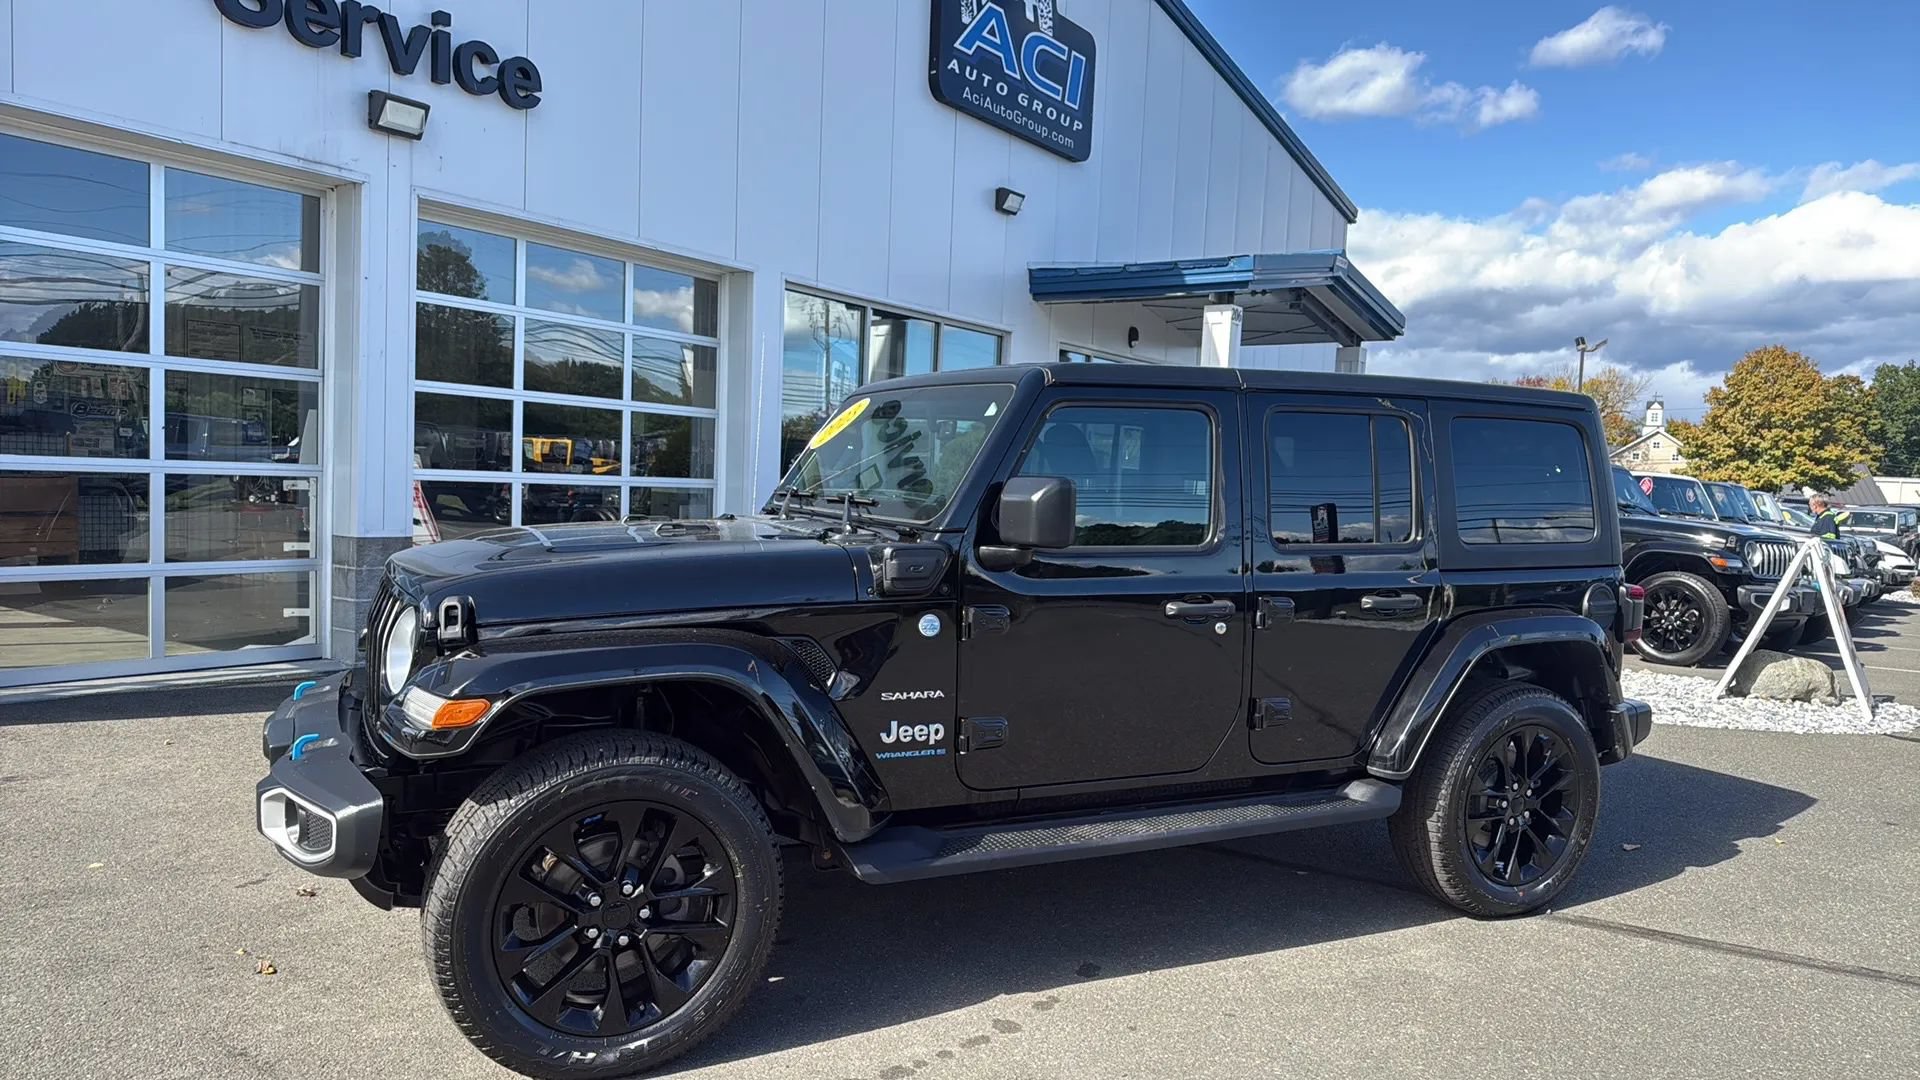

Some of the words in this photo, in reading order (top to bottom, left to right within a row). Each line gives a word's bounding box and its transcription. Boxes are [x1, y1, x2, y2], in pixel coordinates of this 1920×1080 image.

[953, 1, 1086, 110] ACI
[947, 58, 1009, 96] AUTO
[1017, 93, 1083, 132] GROUP
[962, 86, 1075, 149] AciAutoGroup.com
[880, 689, 945, 701] SAHARA
[875, 748, 936, 760] WRANGLER
[879, 720, 945, 746] Jeep
